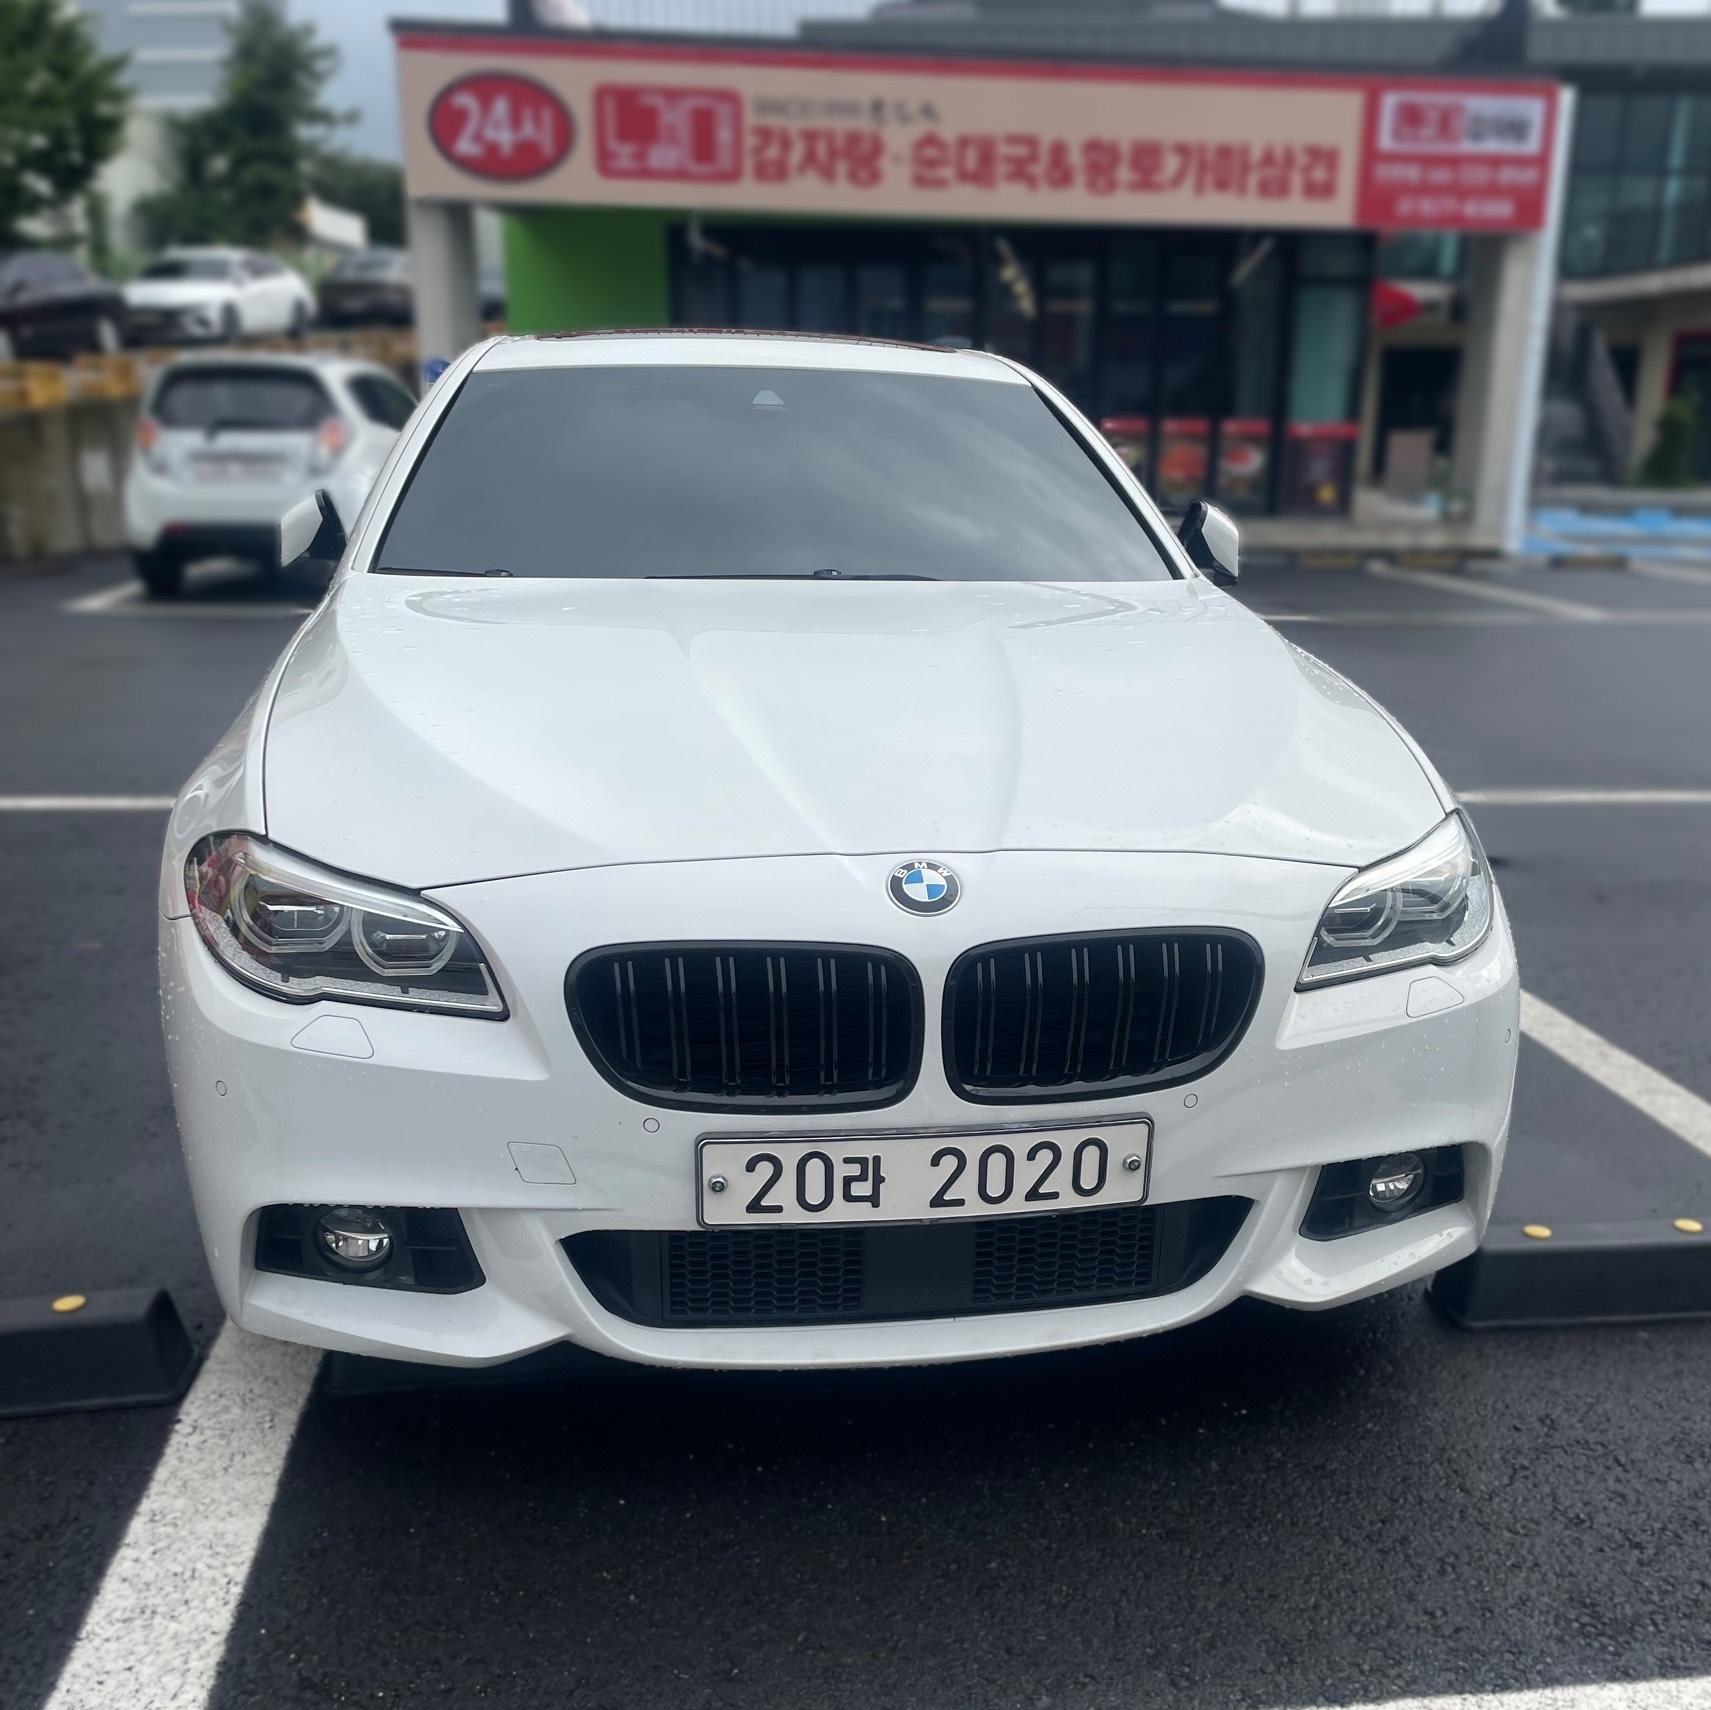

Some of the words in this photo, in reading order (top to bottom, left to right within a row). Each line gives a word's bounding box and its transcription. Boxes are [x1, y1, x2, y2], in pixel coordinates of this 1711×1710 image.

[449, 92, 558, 160] 24시
[890, 861, 952, 878] BMW
[745, 1149, 886, 1214] 20라
[928, 1136, 1110, 1208] 2020
